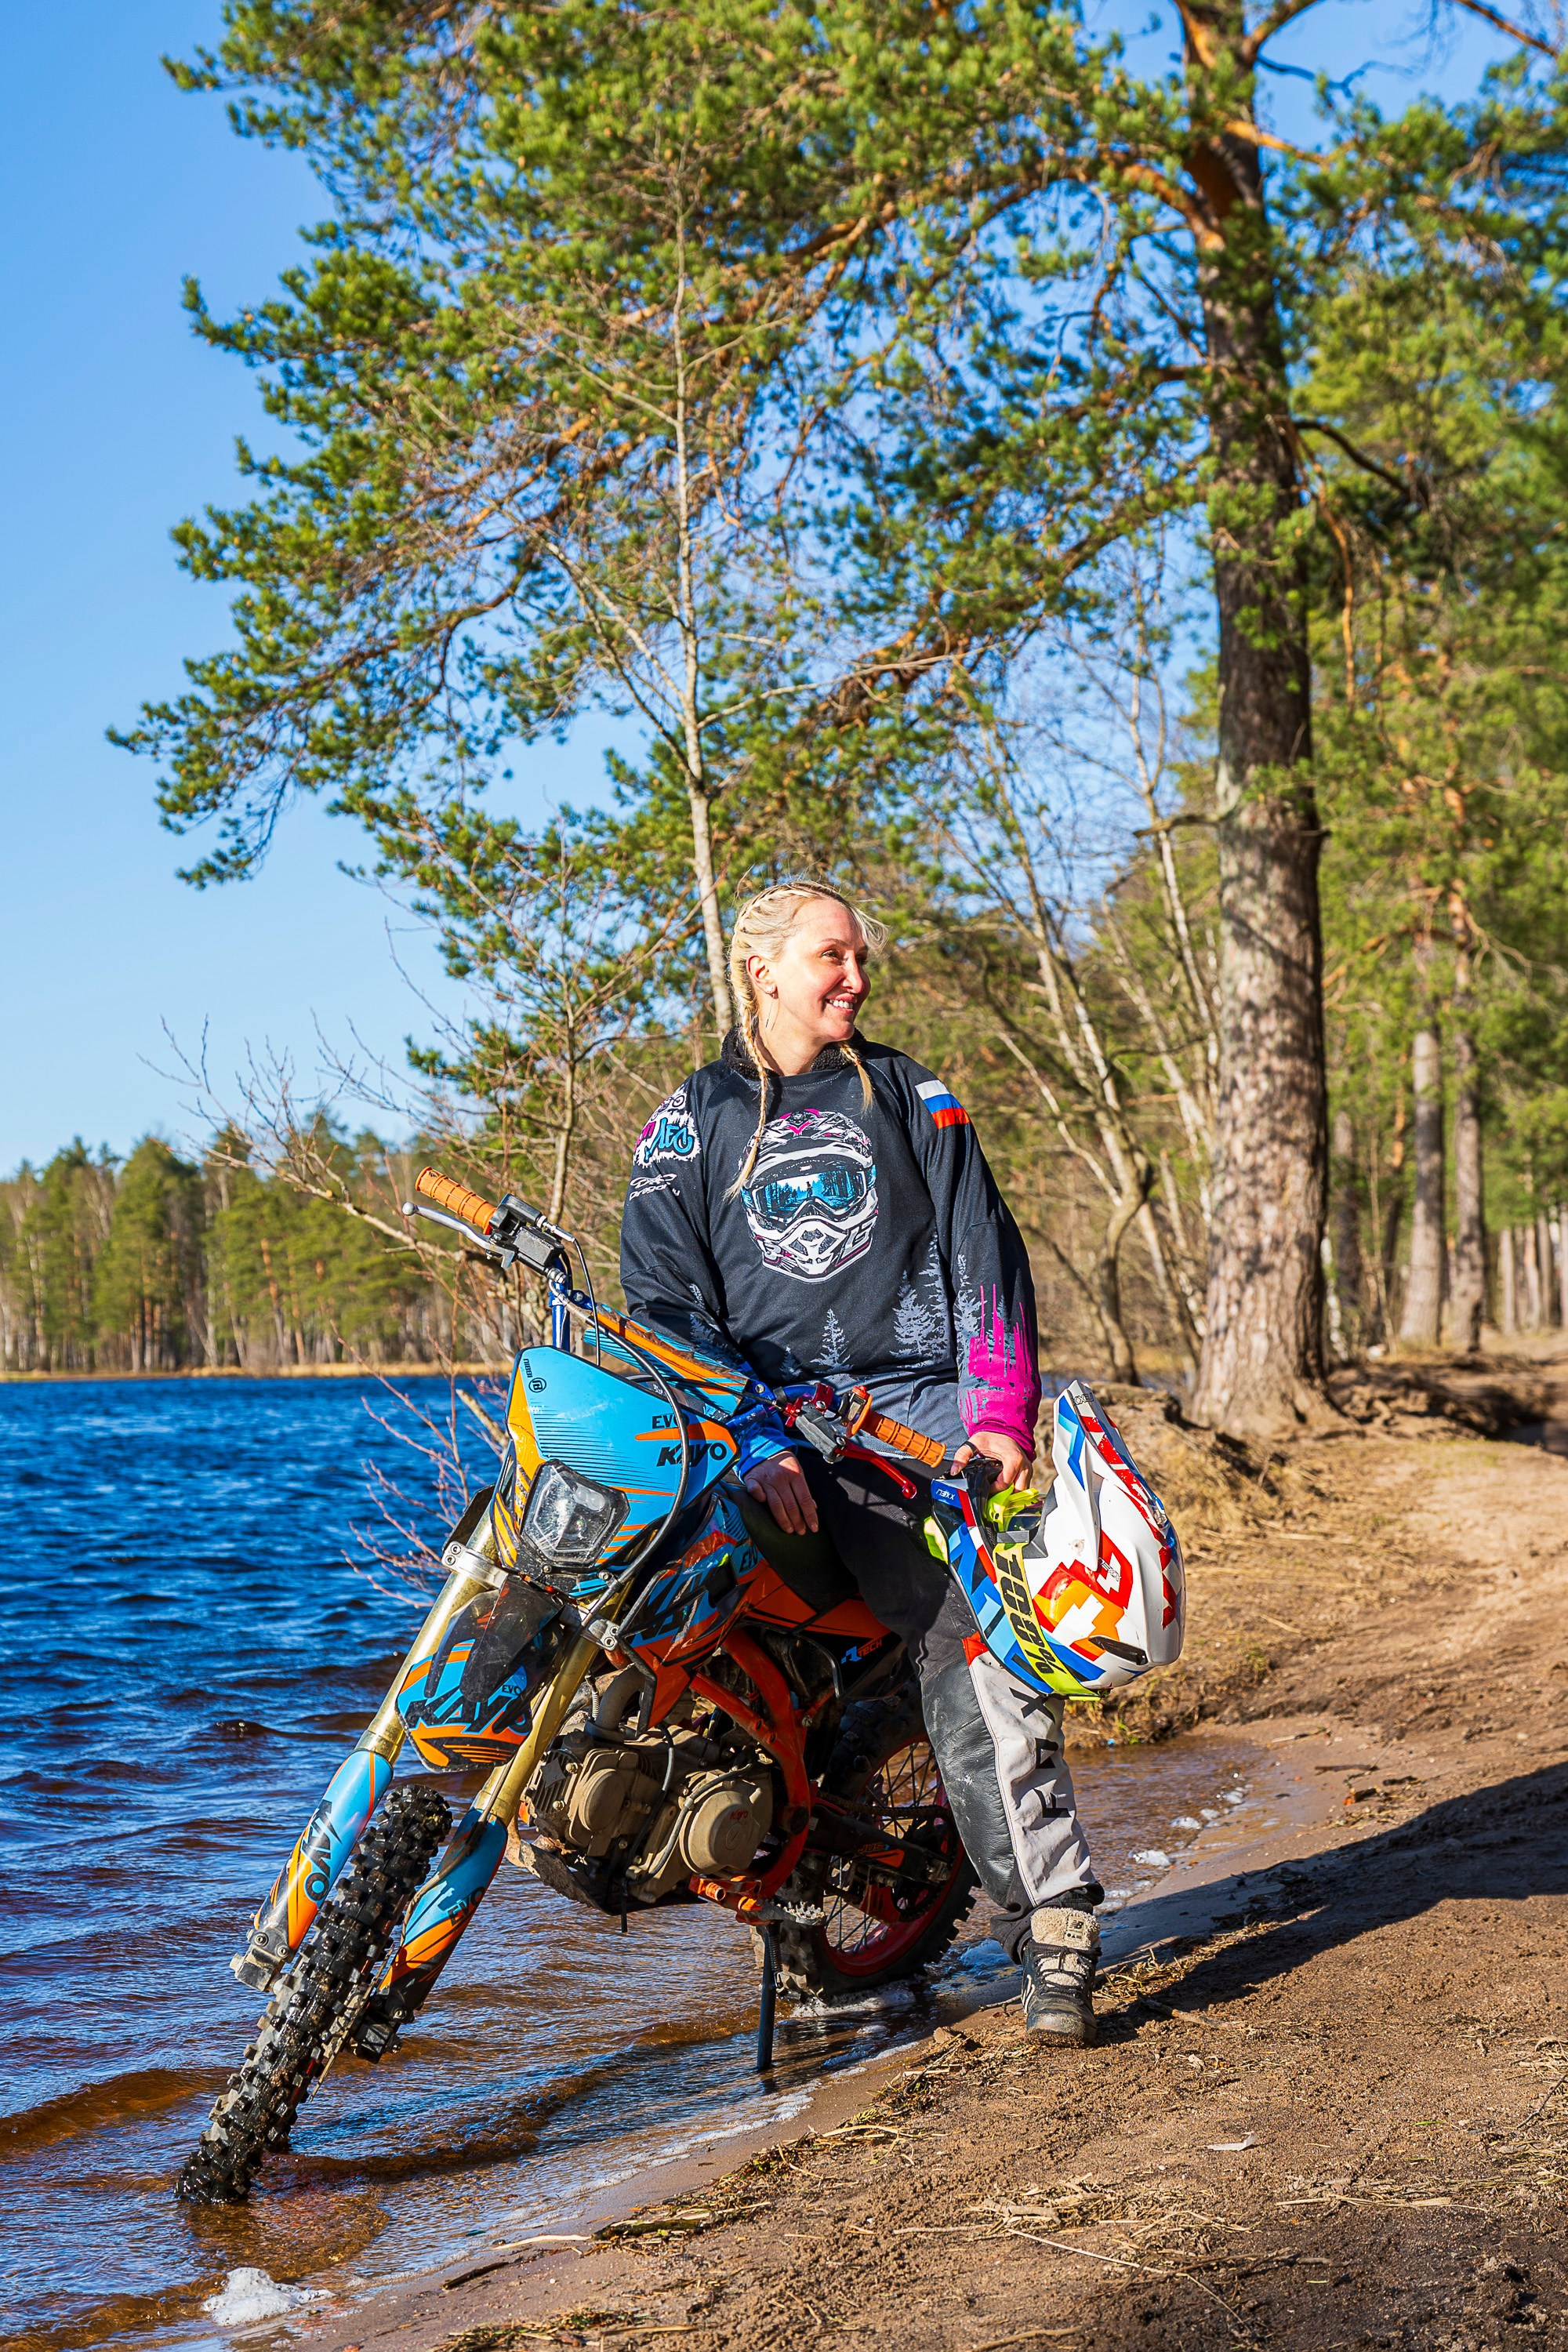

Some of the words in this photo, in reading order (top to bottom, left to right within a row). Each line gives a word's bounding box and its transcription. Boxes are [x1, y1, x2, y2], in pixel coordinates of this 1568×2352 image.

[652, 1413, 690, 1429] EVO
[995, 1552, 1067, 1675] 100%
[501, 1684, 523, 1697] EVO
[301, 1798, 343, 1901] KAYO
[448, 1886, 486, 1927] EVO
